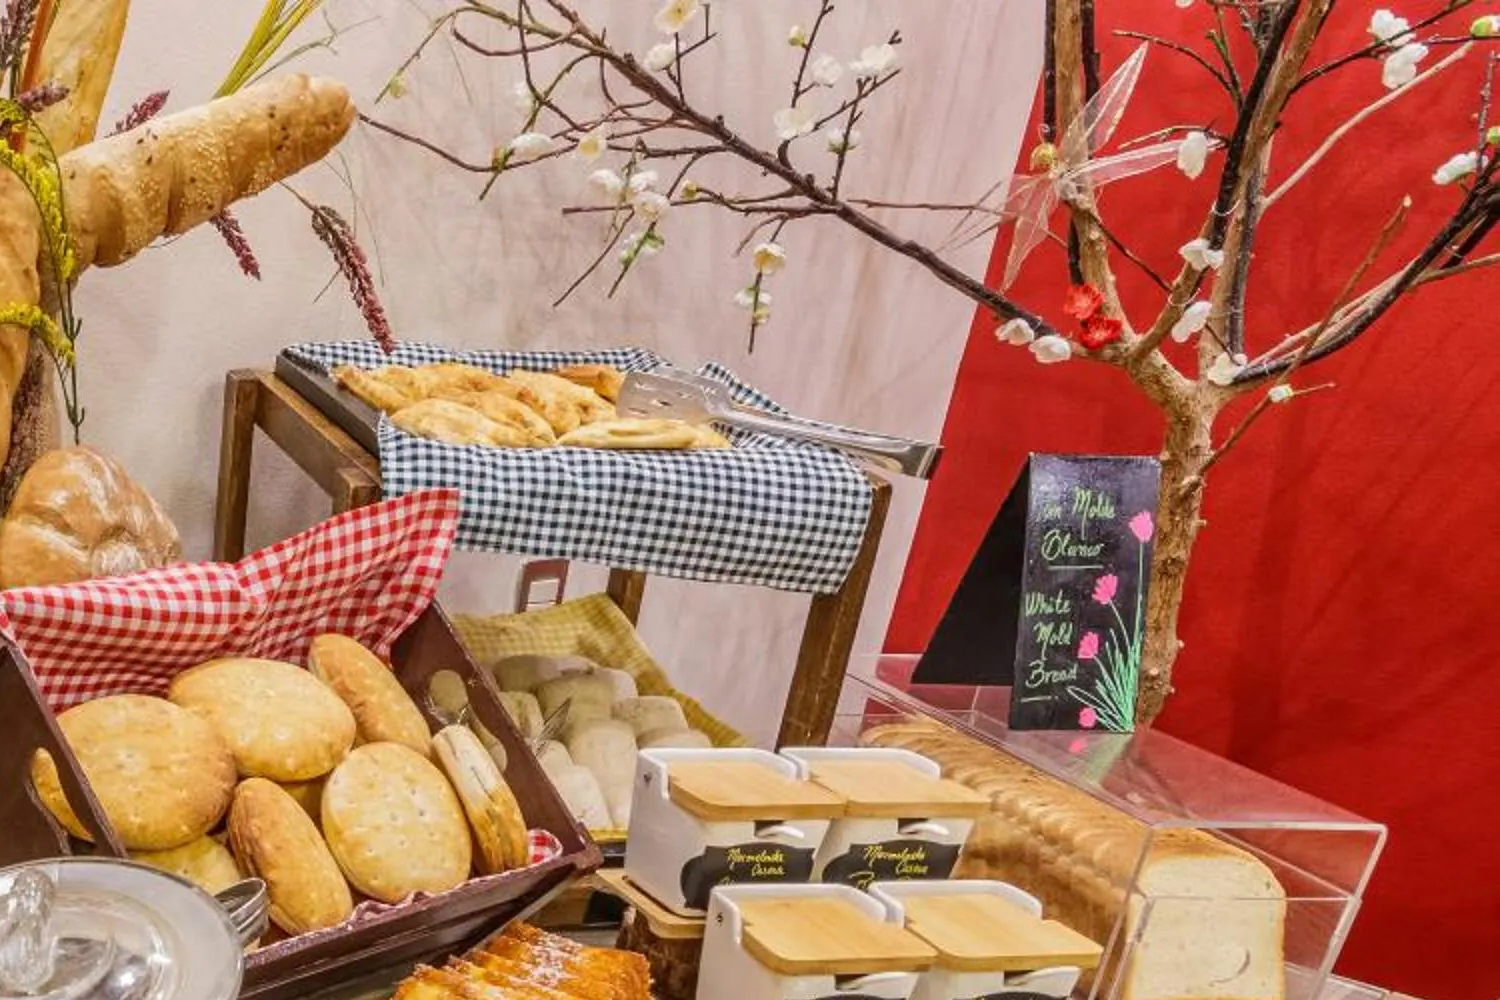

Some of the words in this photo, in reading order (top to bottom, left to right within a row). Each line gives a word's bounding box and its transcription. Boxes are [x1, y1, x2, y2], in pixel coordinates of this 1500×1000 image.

[1025, 588, 1071, 616] White
[1033, 622, 1073, 660] Mold
[1025, 660, 1078, 688] Bread
